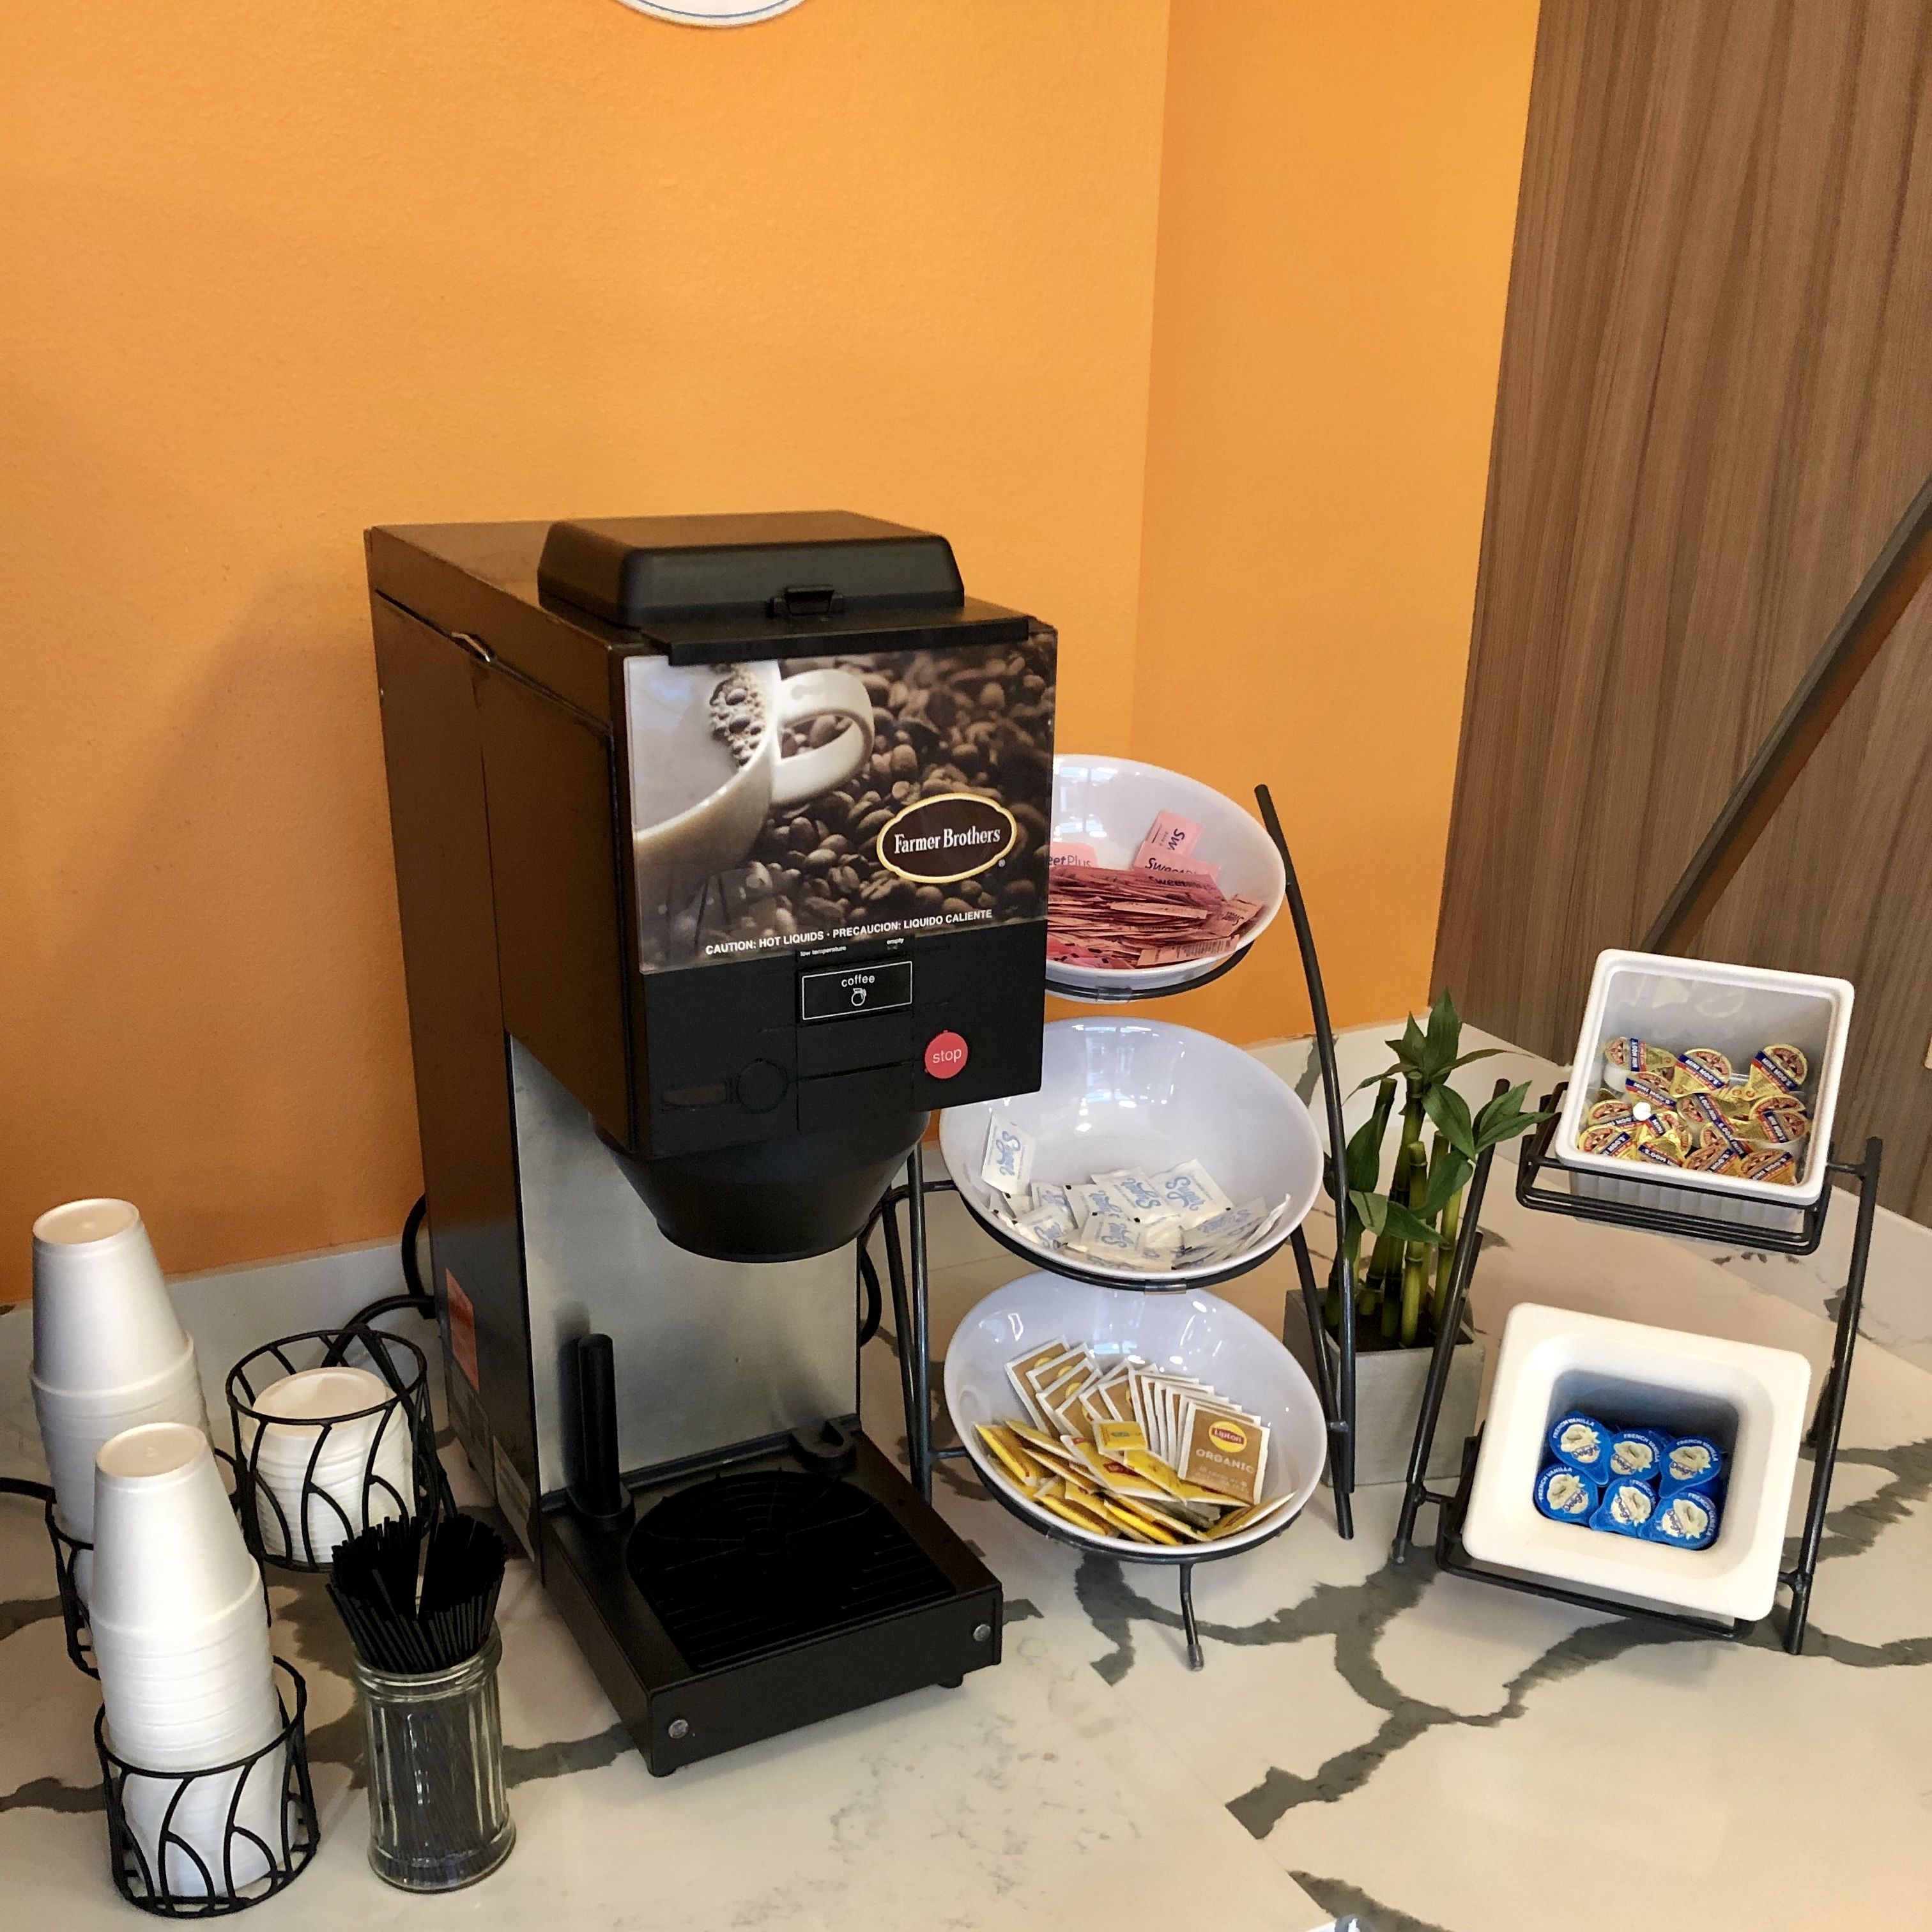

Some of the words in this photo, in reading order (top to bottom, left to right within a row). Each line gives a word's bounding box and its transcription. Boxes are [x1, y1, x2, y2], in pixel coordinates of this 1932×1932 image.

[894, 834, 941, 854] Farmer
[943, 825, 1000, 848] Brothers
[705, 941, 756, 954] CAUTION:
[759, 937, 781, 947] HOT
[783, 930, 824, 944] LIQUIDS
[832, 921, 901, 939] PRECAUCION:
[903, 915, 944, 929] LIQUIDO
[946, 908, 992, 924] CALIENTE
[841, 974, 875, 987] coffee
[933, 1048, 962, 1063] stop
[1685, 1059, 1700, 1070] MINI
[1762, 1057, 1776, 1070] MINI
[996, 1130, 1021, 1176] Sugar
[1121, 1177, 1162, 1209] Sugar
[1165, 1176, 1206, 1211] Sugar
[1214, 1428, 1242, 1443] Lipton
[1552, 1420, 1569, 1439] FRENCH
[1568, 1418, 1595, 1427] VANILLA
[1572, 1445, 1600, 1459] Delight
[1623, 1433, 1649, 1443] FRENCH
[1648, 1441, 1660, 1462] VANILLA
[1703, 1441, 1719, 1462] VANILLA
[1196, 1448, 1255, 1474] ORGANIC
[1538, 1475, 1549, 1500] FRENCH
[1547, 1466, 1572, 1477] VANILLA
[1632, 1480, 1653, 1497] FRENCH
[1563, 1489, 1587, 1512] Delight
[1688, 1492, 1712, 1510] FRENCH
